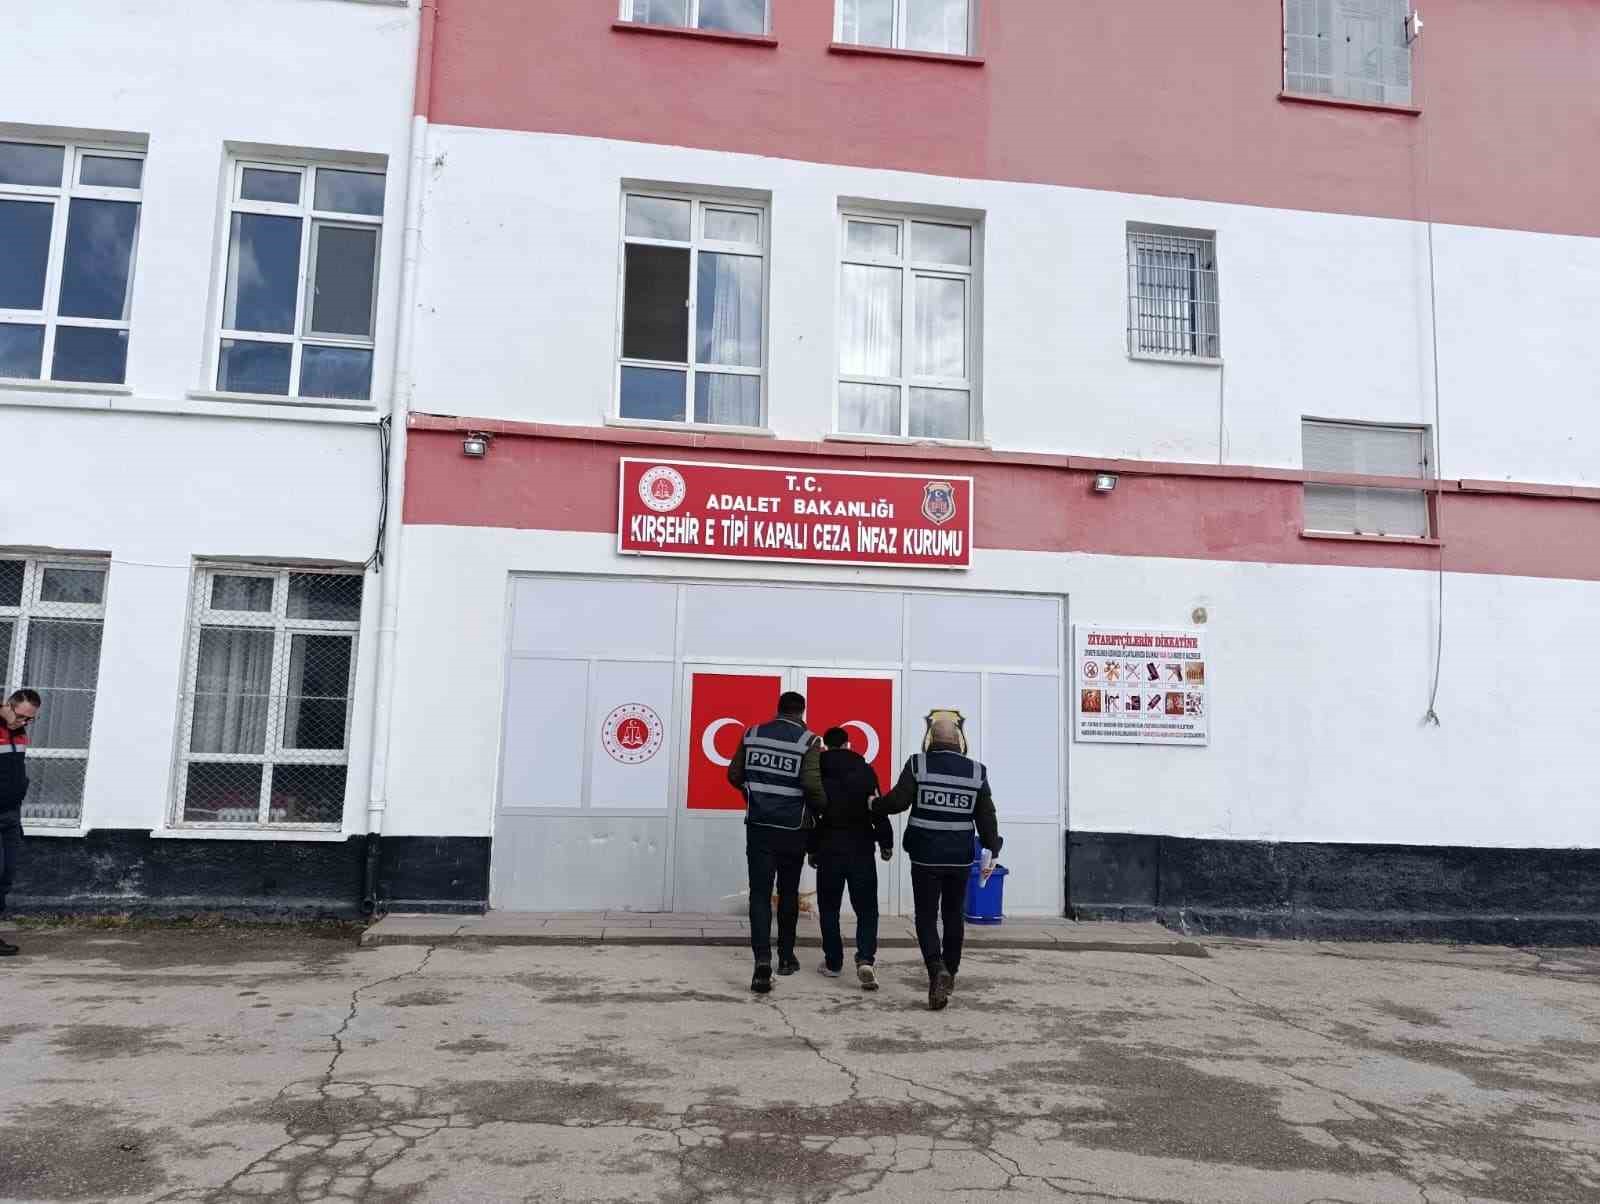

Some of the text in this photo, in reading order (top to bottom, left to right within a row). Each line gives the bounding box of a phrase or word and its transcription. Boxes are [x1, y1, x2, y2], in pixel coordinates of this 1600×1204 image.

[706, 495, 894, 519] ADALET BAKANLIĞI
[631, 512, 963, 557] KIRŞEHİR E TİPİ KAPALI CEZA İNFAZ KURUMU
